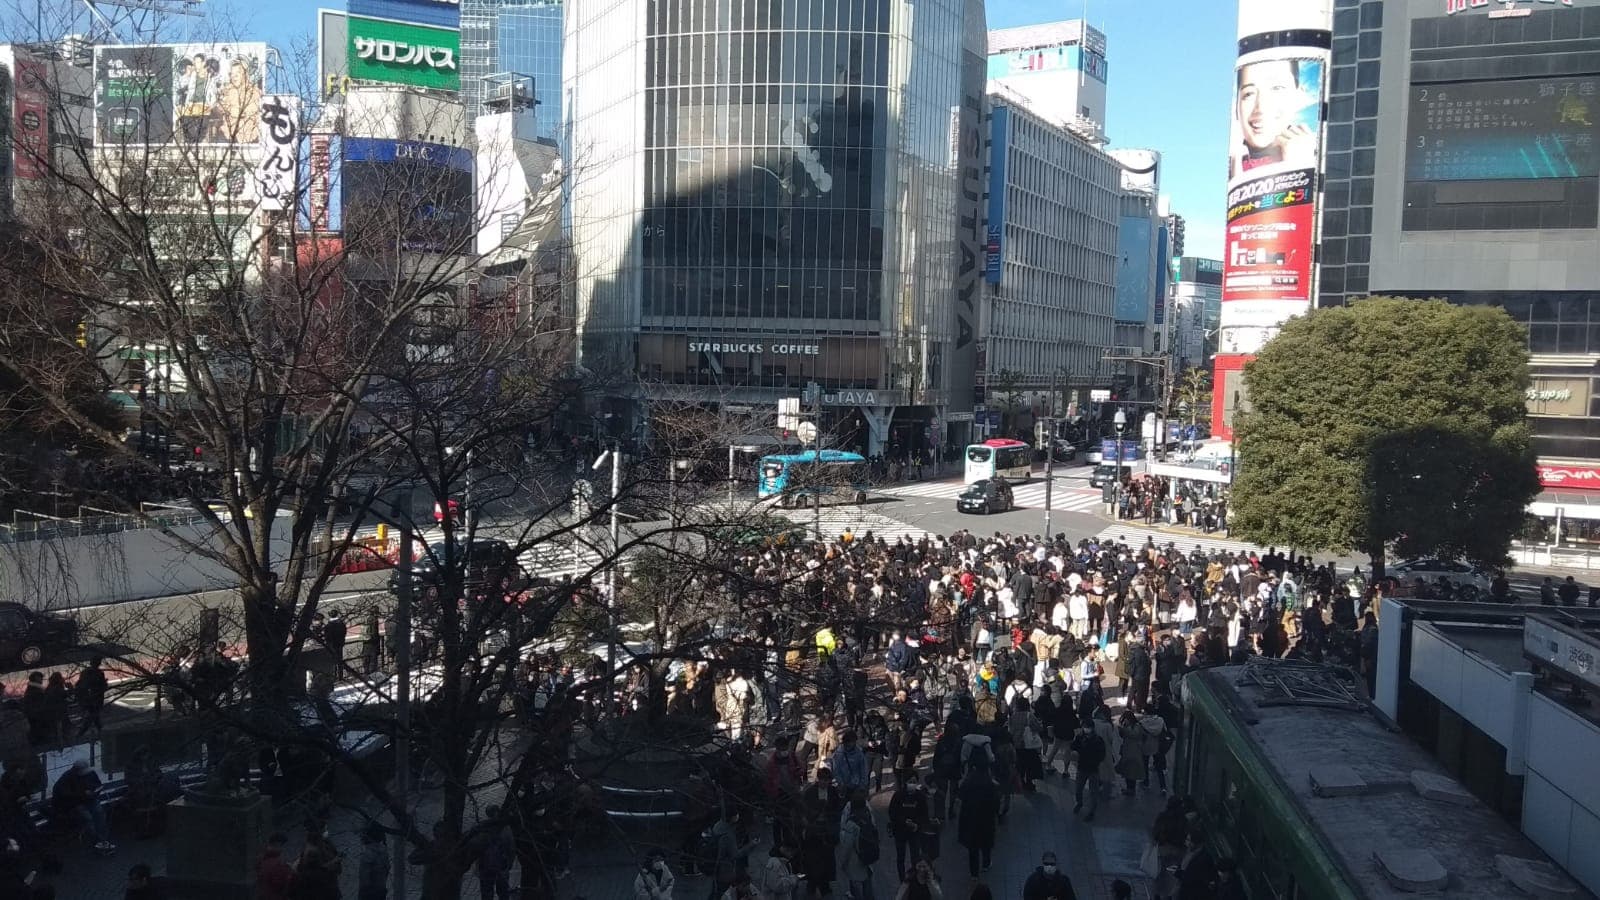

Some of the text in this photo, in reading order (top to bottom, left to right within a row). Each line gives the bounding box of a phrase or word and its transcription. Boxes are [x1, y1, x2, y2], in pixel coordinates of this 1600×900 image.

[354, 36, 456, 70] サロンパス
[956, 86, 984, 351] TSUTAYA
[689, 343, 819, 355] STARBUCKS COFFEE
[802, 390, 876, 405] TUTAYA
